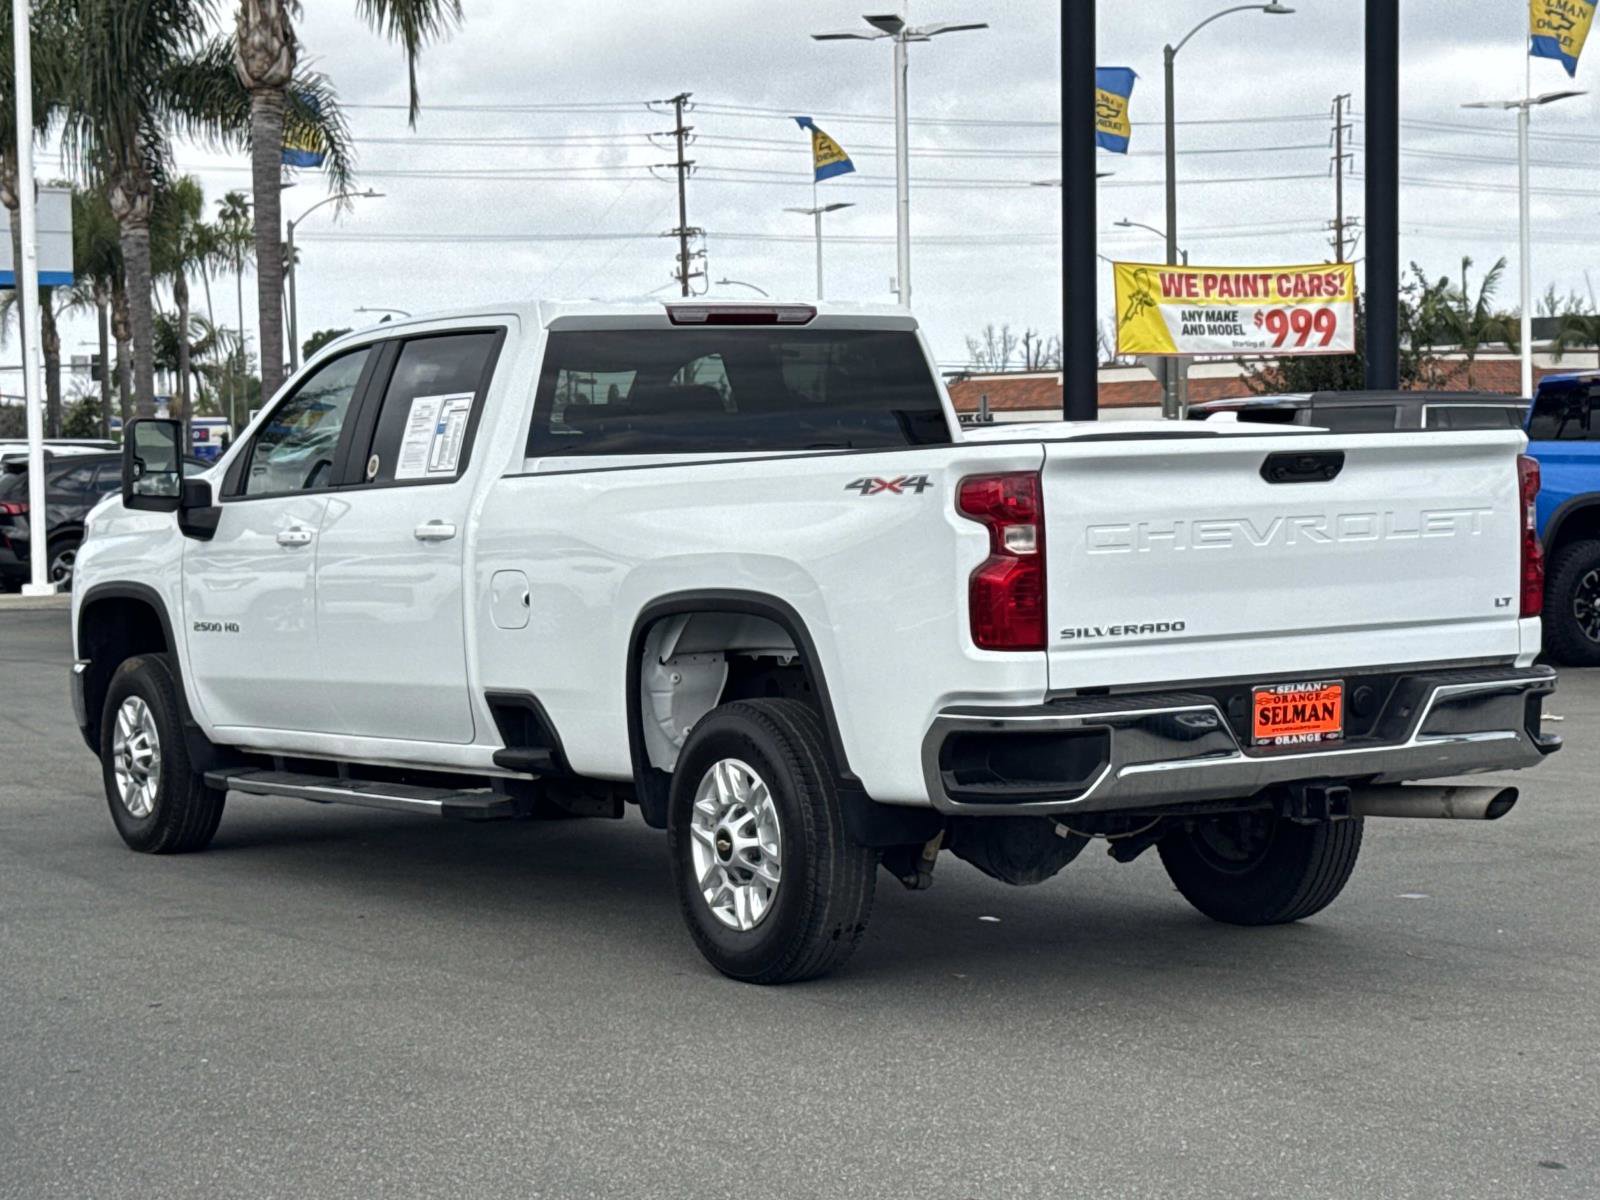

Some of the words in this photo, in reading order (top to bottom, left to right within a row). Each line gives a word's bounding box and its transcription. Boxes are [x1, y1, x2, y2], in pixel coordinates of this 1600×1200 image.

[1545, 0, 1587, 19] LMAN
[1159, 273, 1199, 298] WE
[1203, 272, 1273, 298] PAINT
[1276, 271, 1346, 298] CARS!
[1181, 310, 1204, 323] ANY
[1205, 310, 1239, 323] MAKE
[1253, 307, 1337, 348] $999
[1181, 324, 1206, 336] AND
[1208, 323, 1246, 336] MODEL
[1085, 505, 1493, 555] CHEVROLET
[1494, 597, 1513, 608] LT
[193, 621, 222, 632] 2500
[224, 622, 240, 633] HD
[1060, 620, 1186, 640] SILVERADO
[1276, 682, 1321, 694] SELMAN
[1273, 692, 1321, 704] ORANGE
[1259, 701, 1335, 726] SELMAN
[1275, 732, 1322, 745] ORANGE
